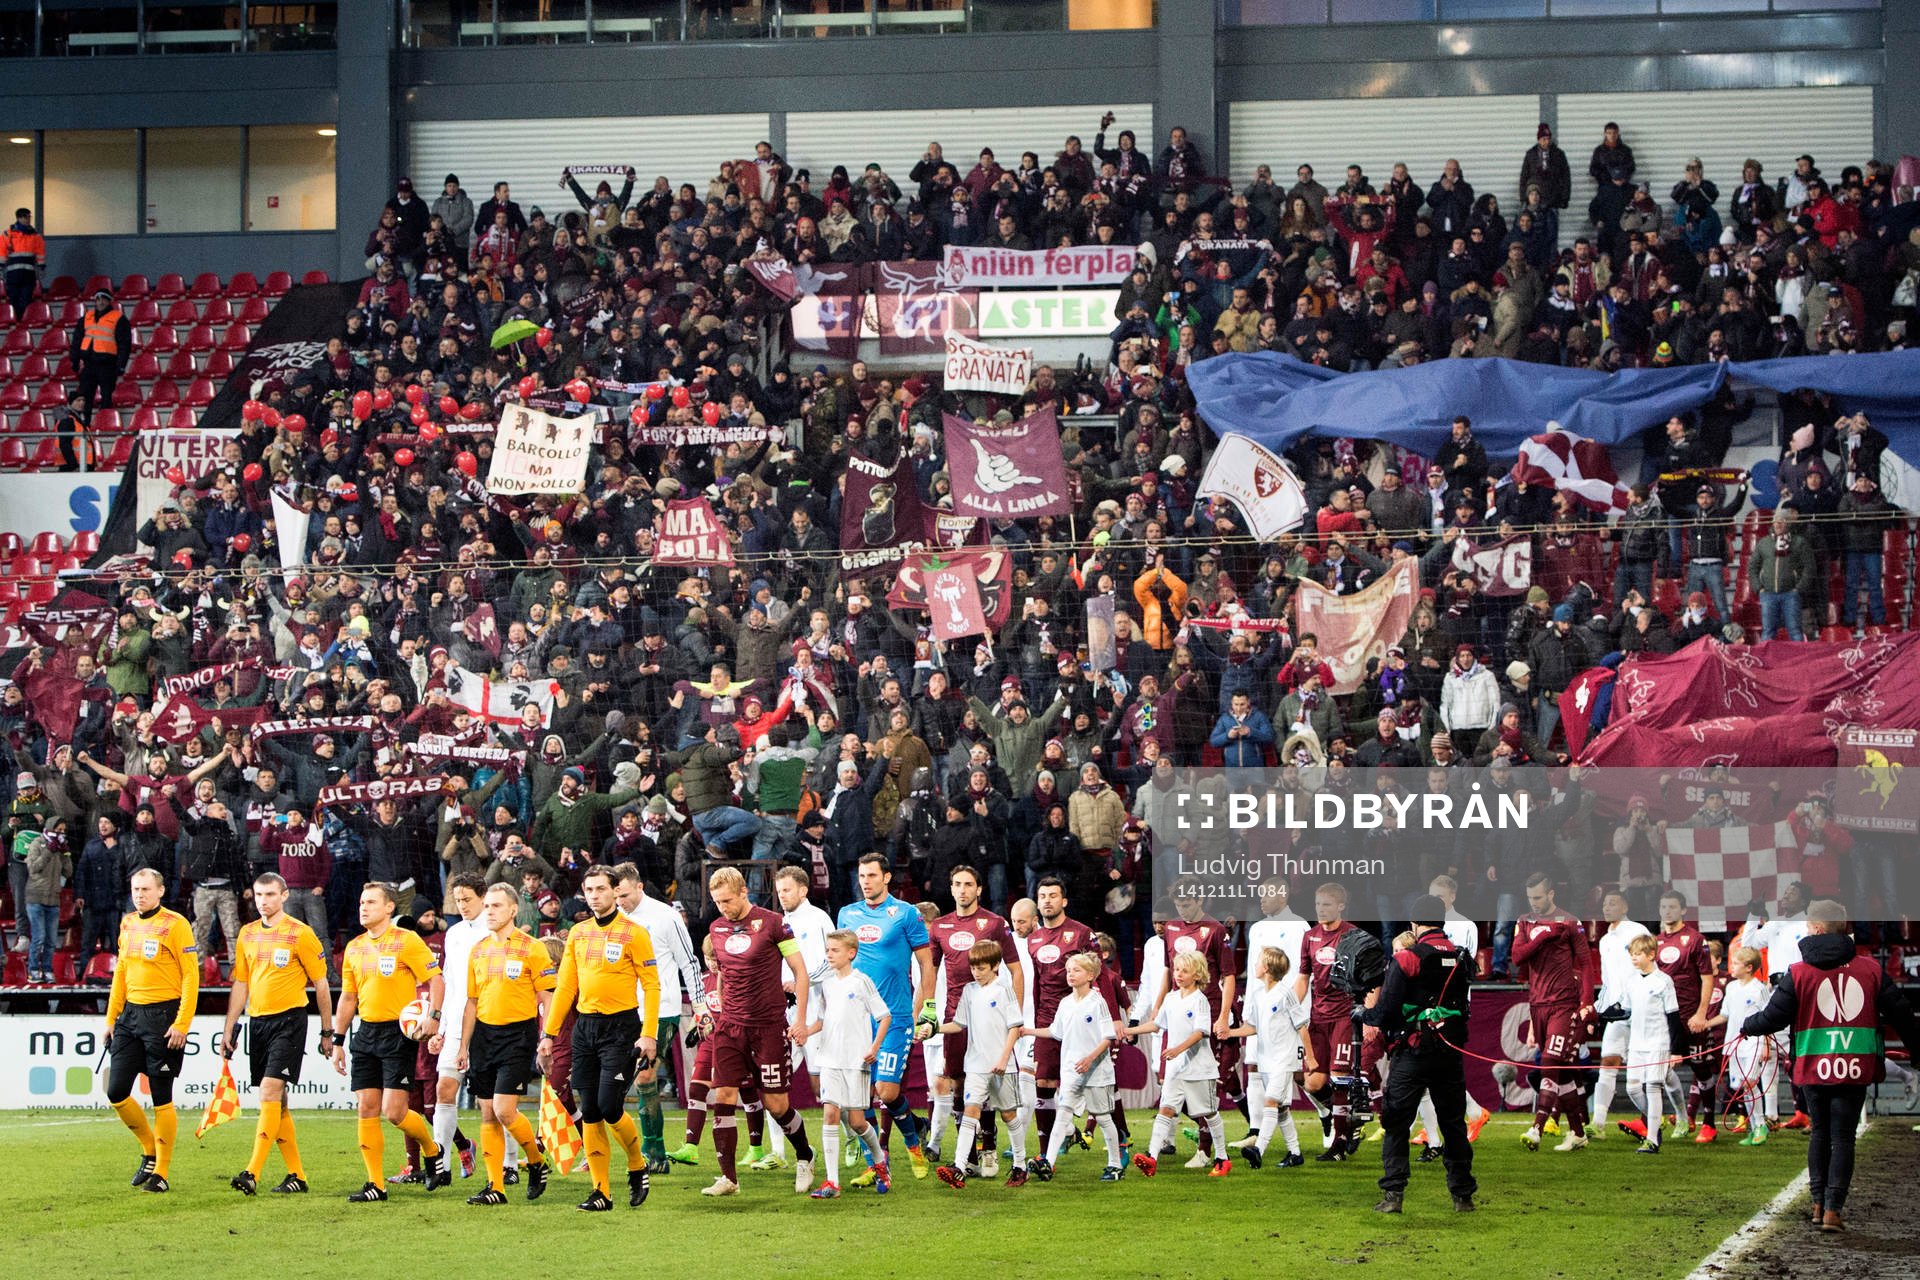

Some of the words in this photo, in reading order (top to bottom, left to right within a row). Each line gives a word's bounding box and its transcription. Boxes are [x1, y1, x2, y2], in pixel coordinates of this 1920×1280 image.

[946, 358, 1025, 385] GRANATA
[507, 439, 581, 460] BARCOLLO
[529, 464, 552, 477] MA
[493, 477, 526, 491] NON
[962, 492, 1003, 513] ALLA
[1008, 490, 1060, 514] LINEA
[1686, 785, 1750, 806] SEPRE
[281, 843, 316, 858] TORO
[1549, 1034, 1565, 1053] 19
[1826, 1030, 1854, 1050] TV
[1336, 1043, 1352, 1061] 14
[878, 1052, 898, 1073] 30
[1817, 1057, 1862, 1080] 006
[761, 1064, 781, 1083] 25
